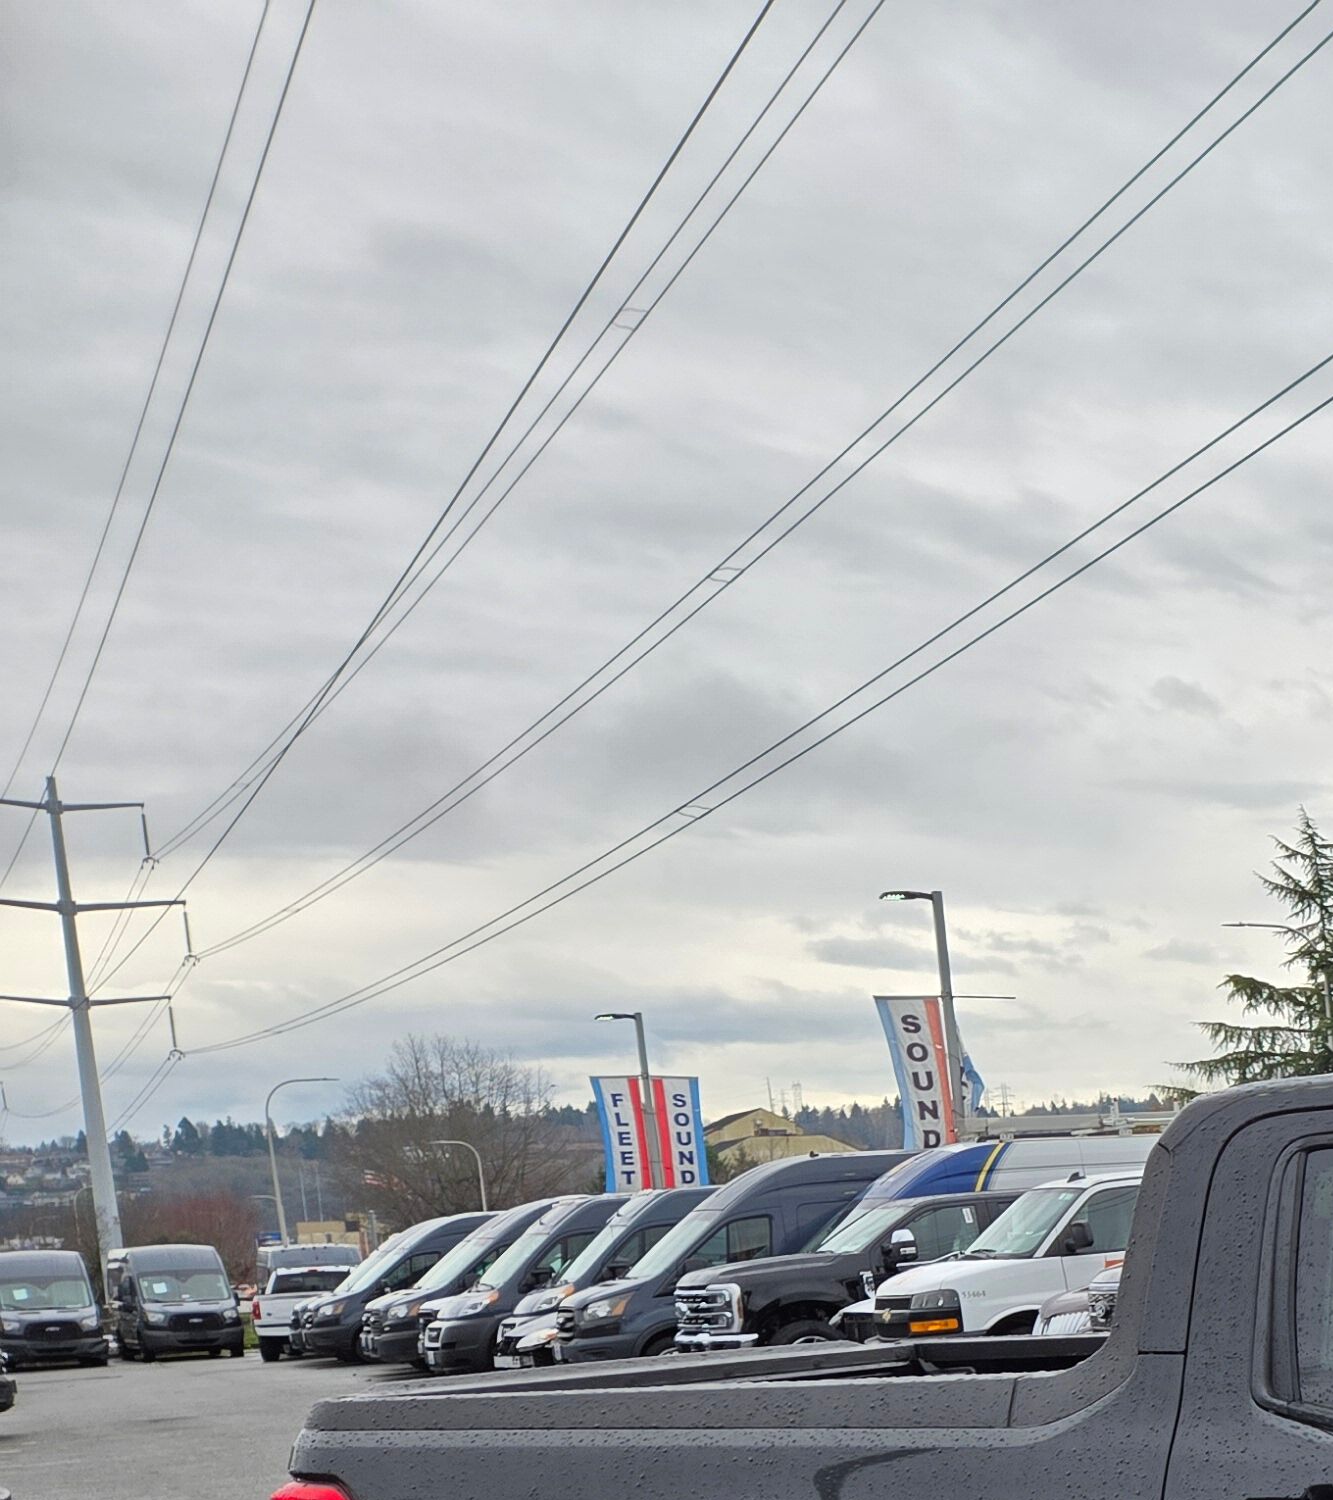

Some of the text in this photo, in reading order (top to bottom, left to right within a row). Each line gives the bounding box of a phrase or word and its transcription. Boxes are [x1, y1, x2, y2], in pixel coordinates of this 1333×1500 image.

[900, 1014, 941, 1149] SOUND
[610, 1093, 636, 1185] FLEET
[672, 1093, 696, 1184] SOUND
